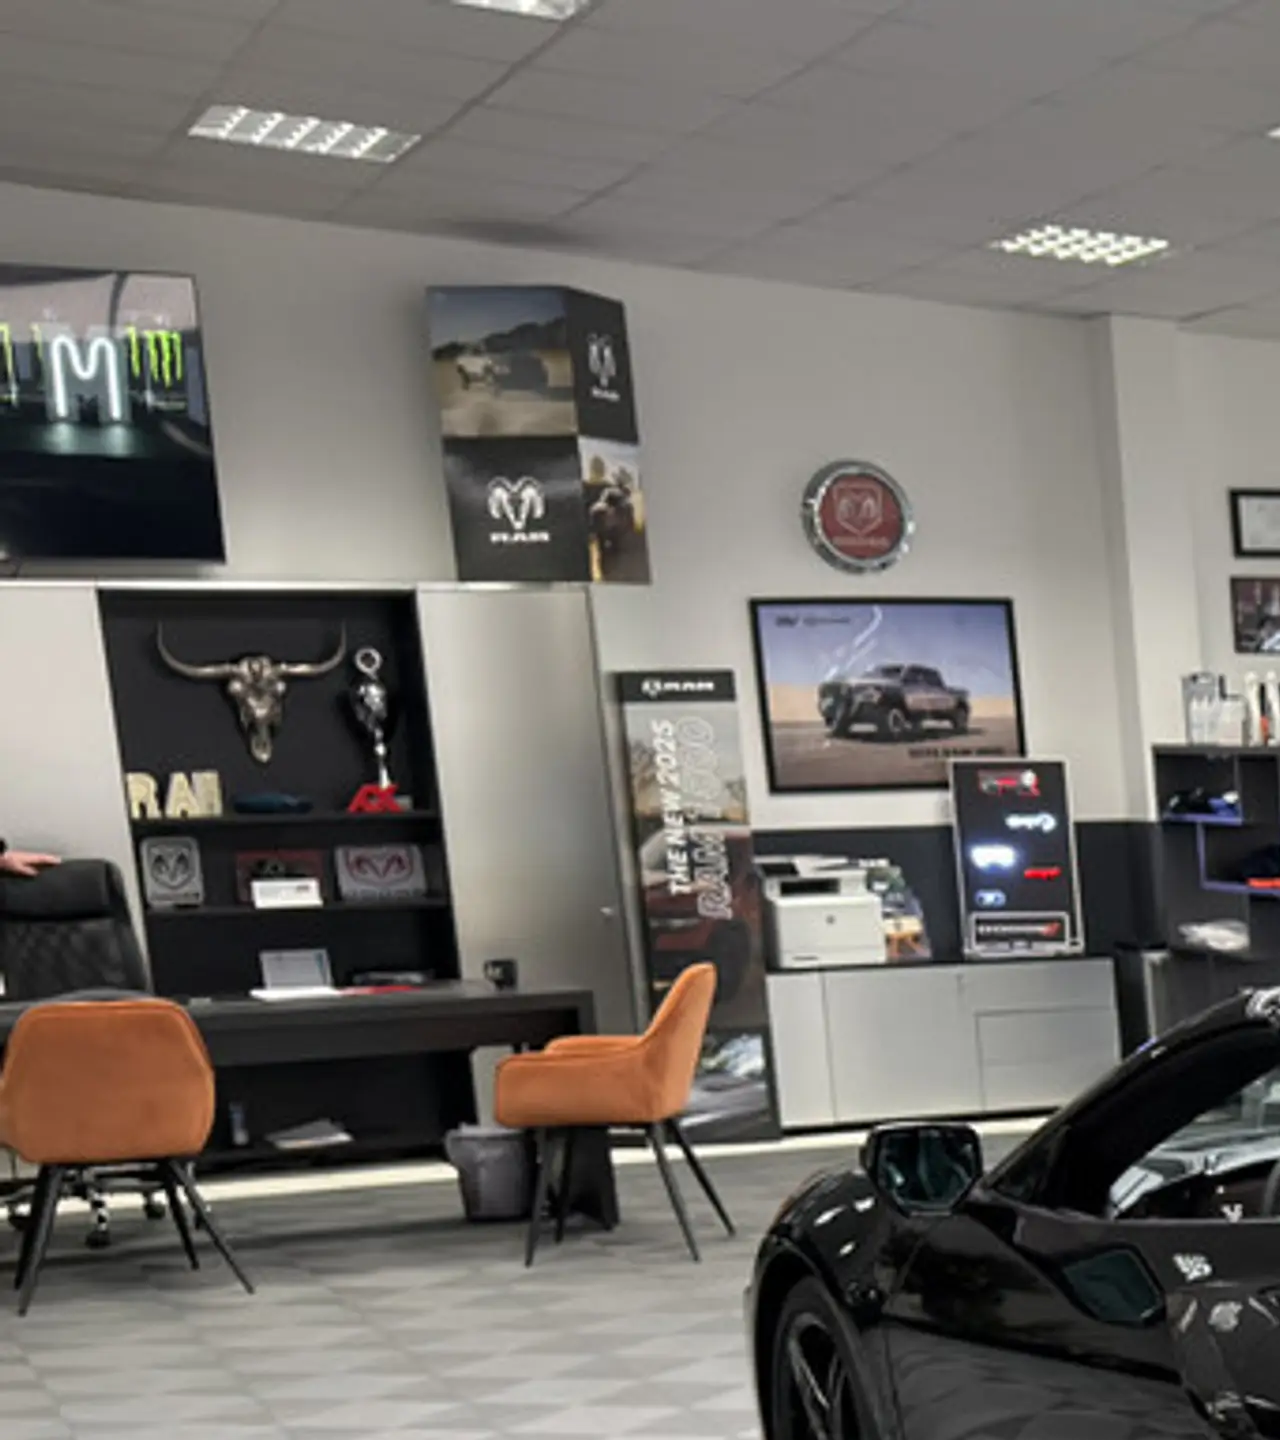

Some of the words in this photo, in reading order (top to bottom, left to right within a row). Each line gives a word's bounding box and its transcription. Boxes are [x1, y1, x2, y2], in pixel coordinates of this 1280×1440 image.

[490, 531, 549, 543] RAM
[652, 718, 681, 787] 2025
[126, 770, 222, 819] RAM
[659, 786, 688, 849] NEW
[666, 850, 692, 895] THE
[690, 831, 733, 919] RAM
